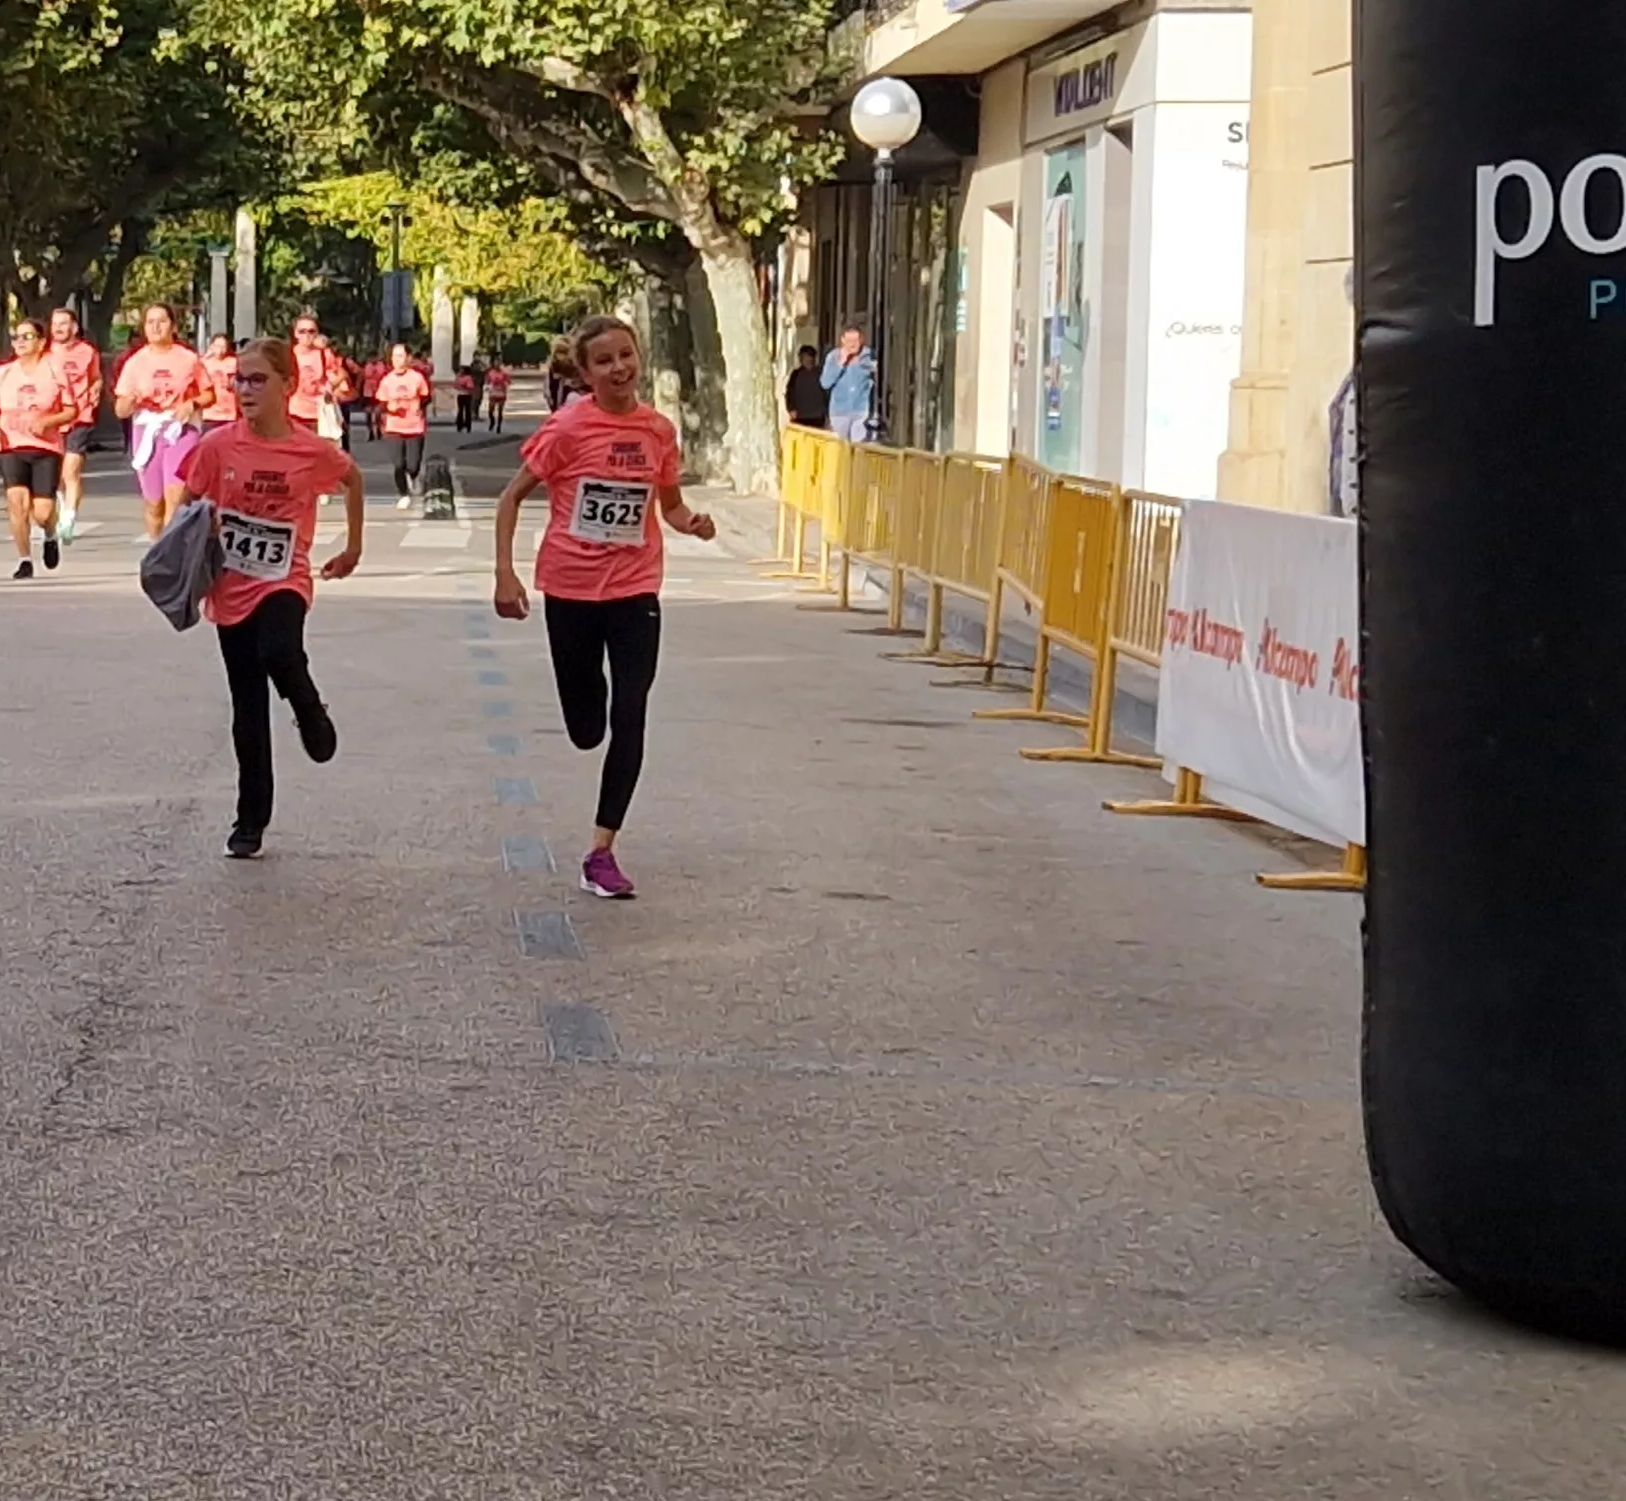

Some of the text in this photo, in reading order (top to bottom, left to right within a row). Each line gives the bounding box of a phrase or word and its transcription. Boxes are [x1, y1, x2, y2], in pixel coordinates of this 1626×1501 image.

[1474, 153, 1626, 327] po
[1590, 279, 1617, 319] P
[582, 499, 643, 526] 3625
[222, 531, 285, 564] 1413
[1255, 617, 1319, 695] Alcampo
